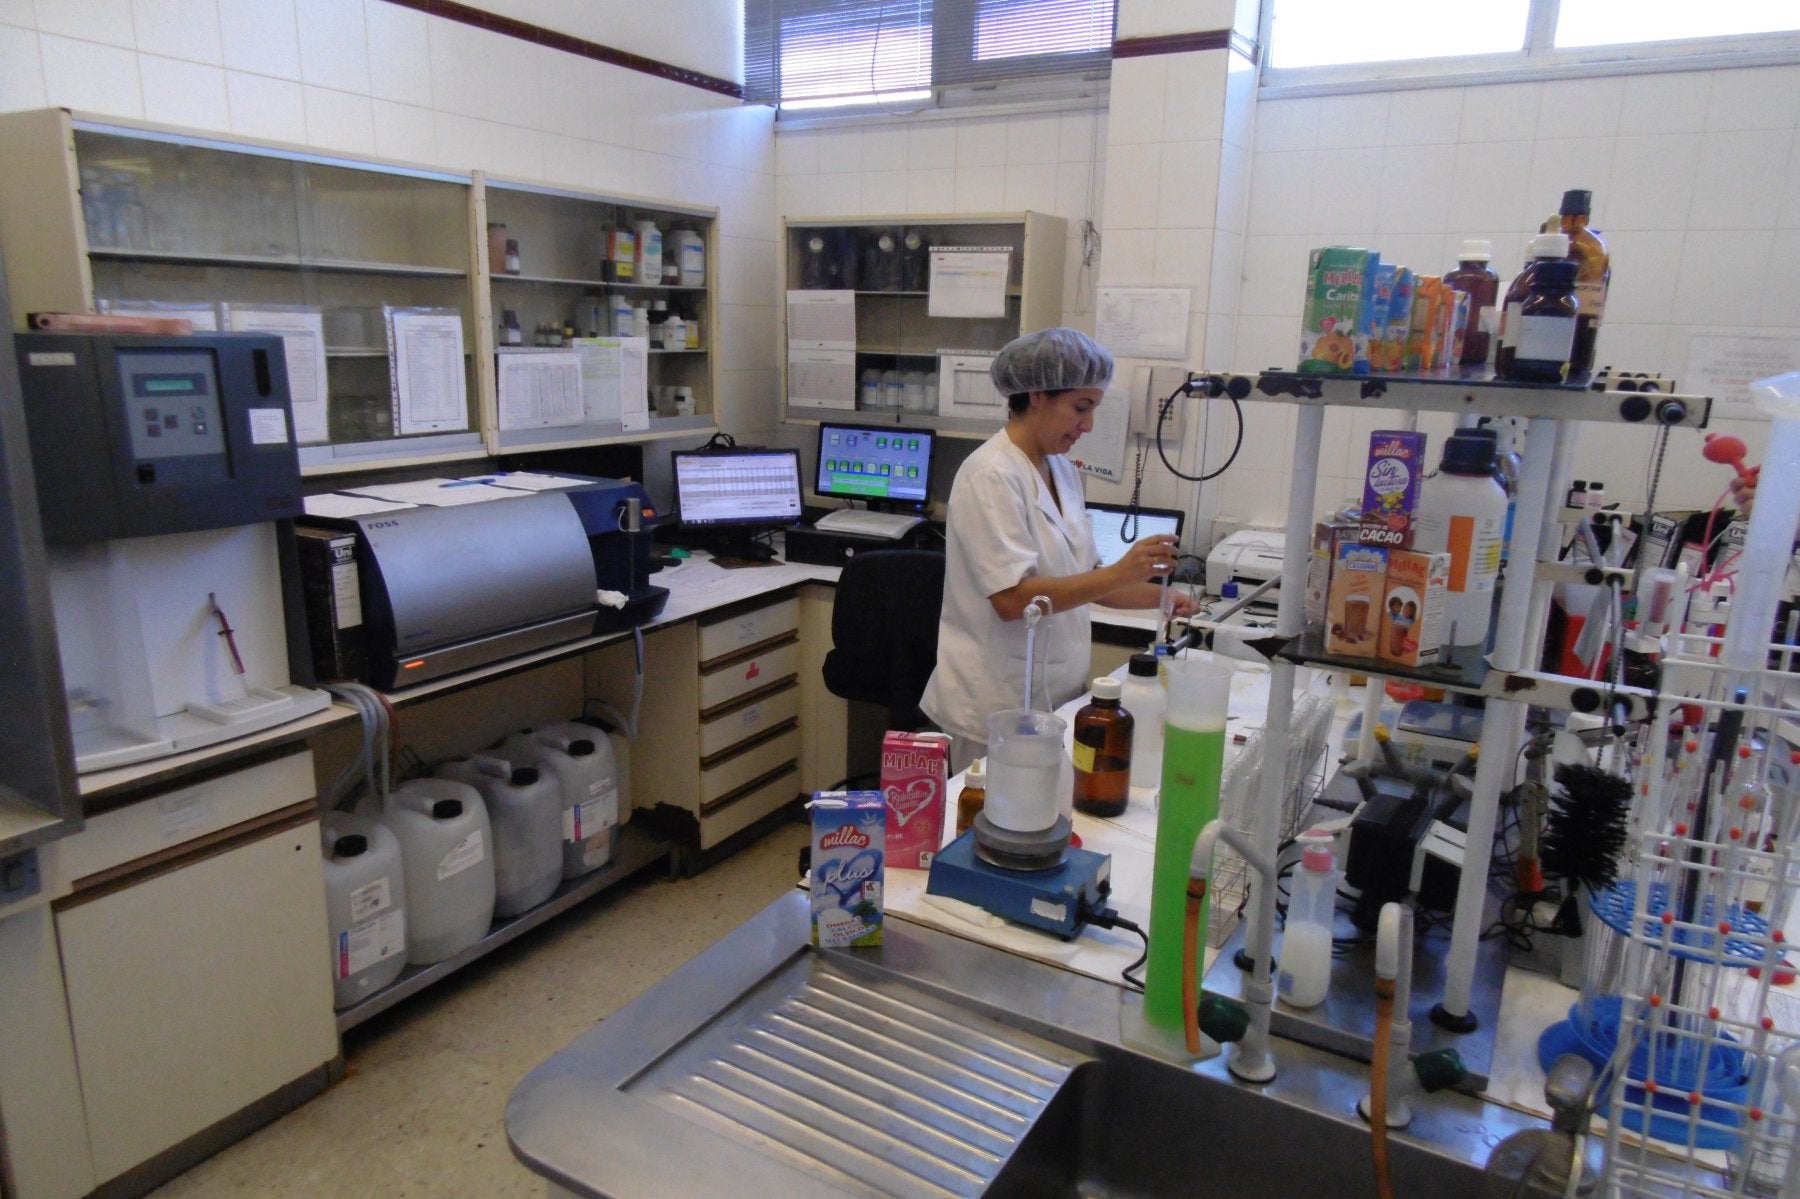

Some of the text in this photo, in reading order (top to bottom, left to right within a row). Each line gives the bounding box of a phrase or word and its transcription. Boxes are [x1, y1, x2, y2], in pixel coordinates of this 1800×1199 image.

[1095, 466, 1113, 476] VIDA
[1371, 460, 1398, 479] Sin
[368, 520, 399, 529] FOSS
[1360, 528, 1403, 544] CACAO
[883, 751, 938, 775] MILLAC
[823, 824, 867, 848] millac
[824, 859, 875, 895] plus
